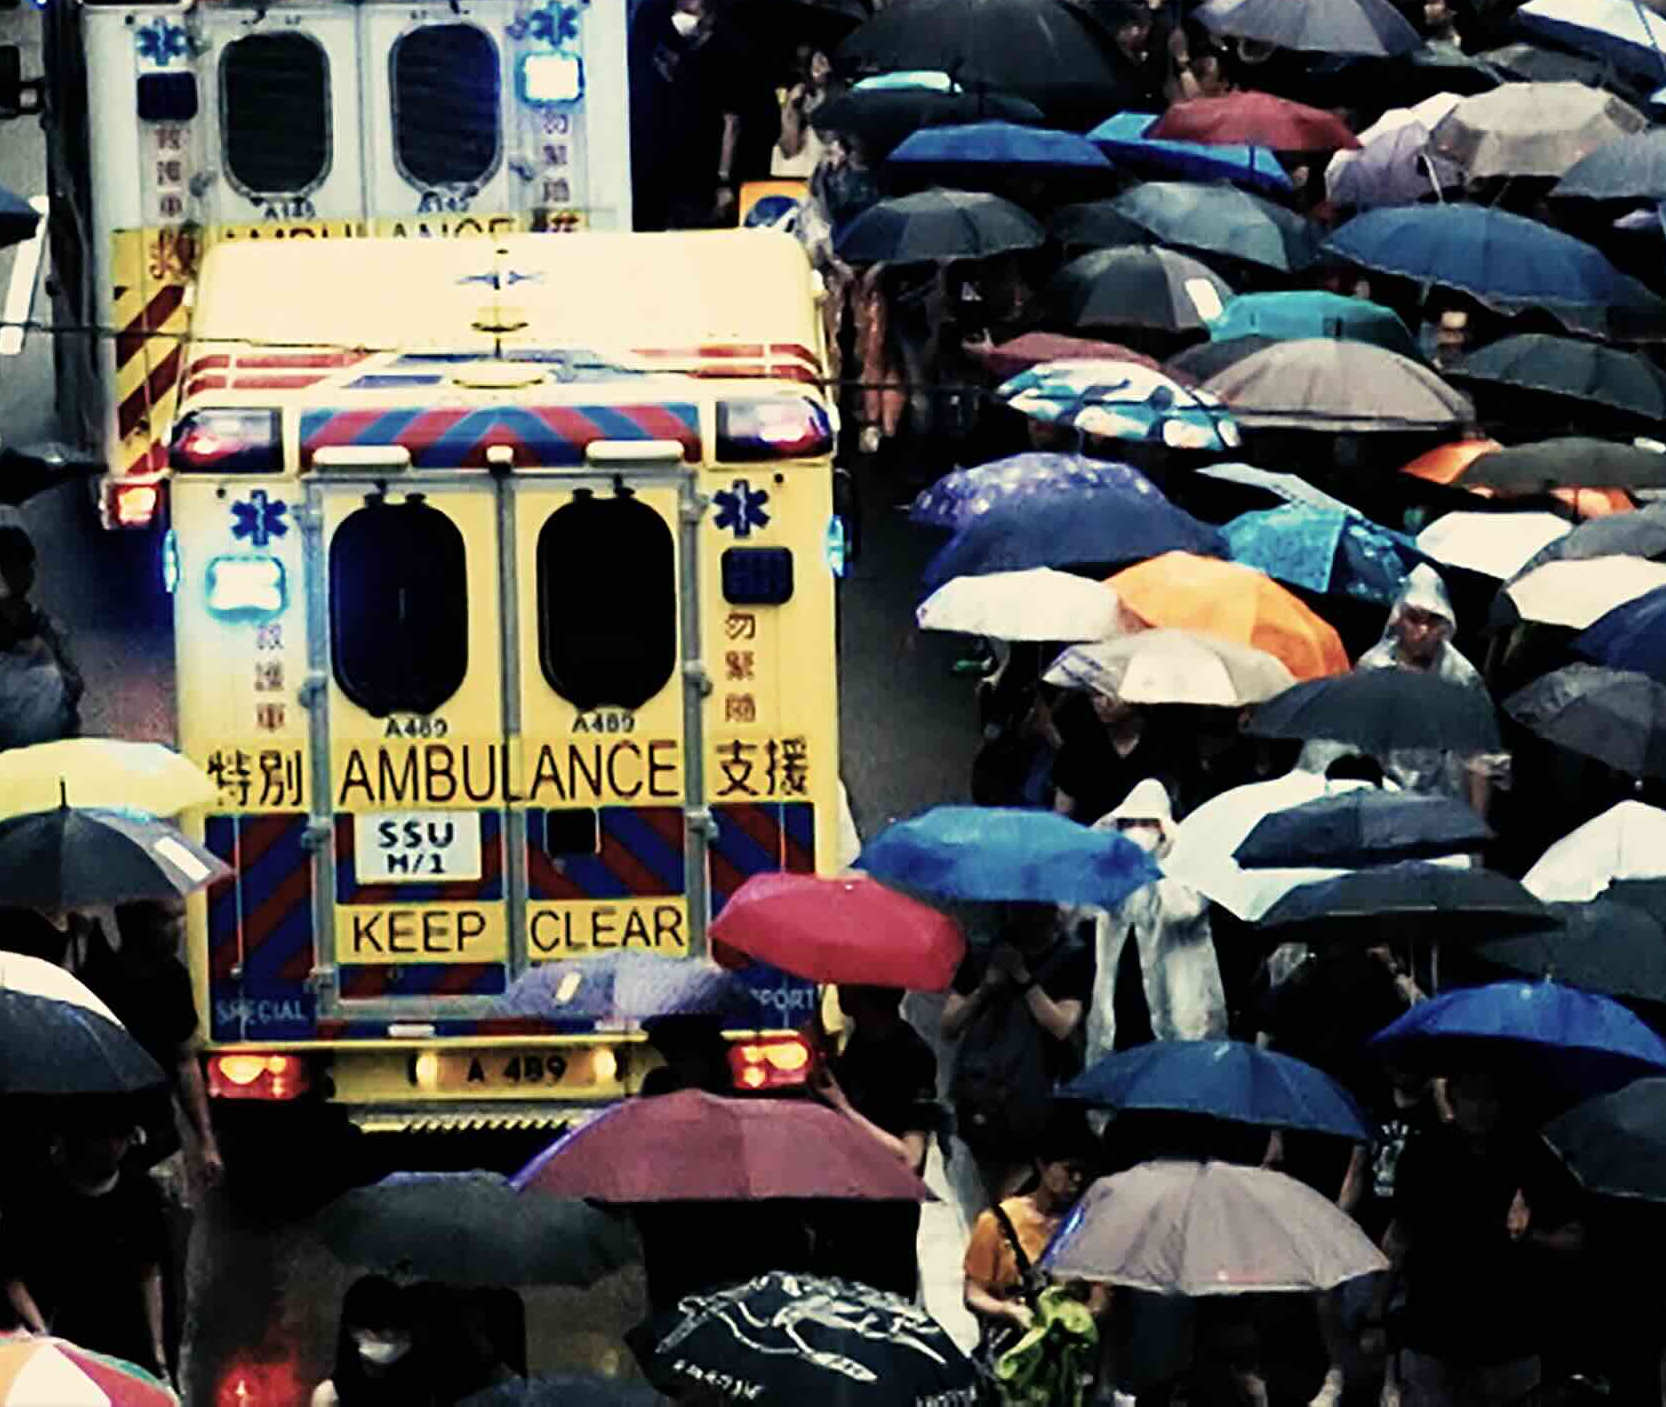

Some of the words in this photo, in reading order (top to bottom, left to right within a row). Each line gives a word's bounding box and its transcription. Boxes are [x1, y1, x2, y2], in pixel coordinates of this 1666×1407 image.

[384, 715, 448, 739] A489
[571, 712, 635, 734] A489
[208, 750, 303, 806] 特別
[339, 740, 679, 805] AMBULANCE
[716, 737, 808, 796] 支援
[378, 820, 455, 849] SSU
[353, 910, 486, 953] KEEP
[530, 905, 686, 953] CLEAR
[749, 987, 815, 1011] PORT
[467, 1055, 484, 1083] A
[501, 1055, 568, 1084] 489
